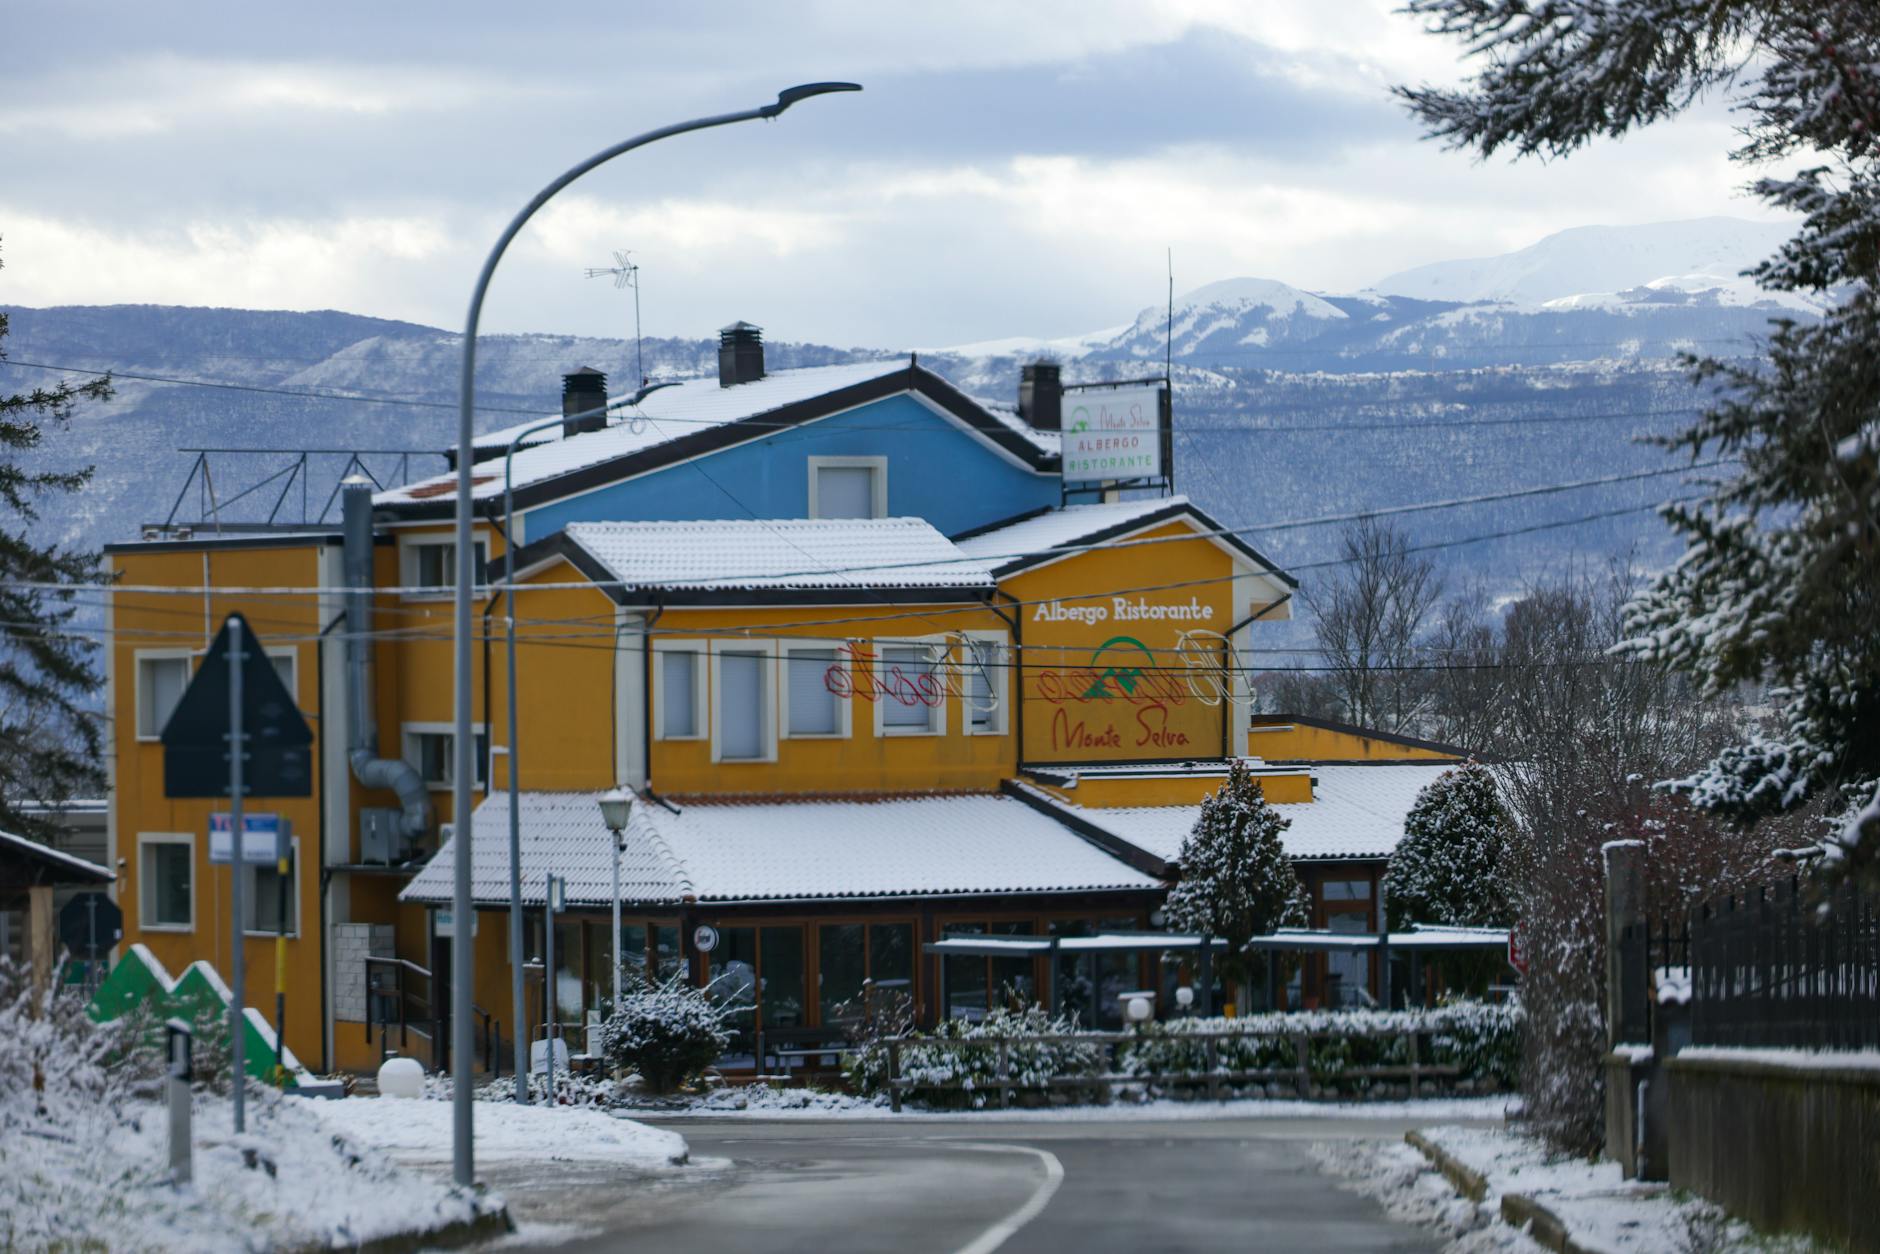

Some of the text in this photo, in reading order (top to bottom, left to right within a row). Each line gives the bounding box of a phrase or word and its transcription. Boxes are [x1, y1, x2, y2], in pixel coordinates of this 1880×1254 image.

[1078, 436, 1140, 451] ALBERGO
[1069, 455, 1152, 472] RISTORANTE
[1033, 597, 1214, 625] Albergo Ristorante
[1052, 703, 1189, 752] Monte Selva
